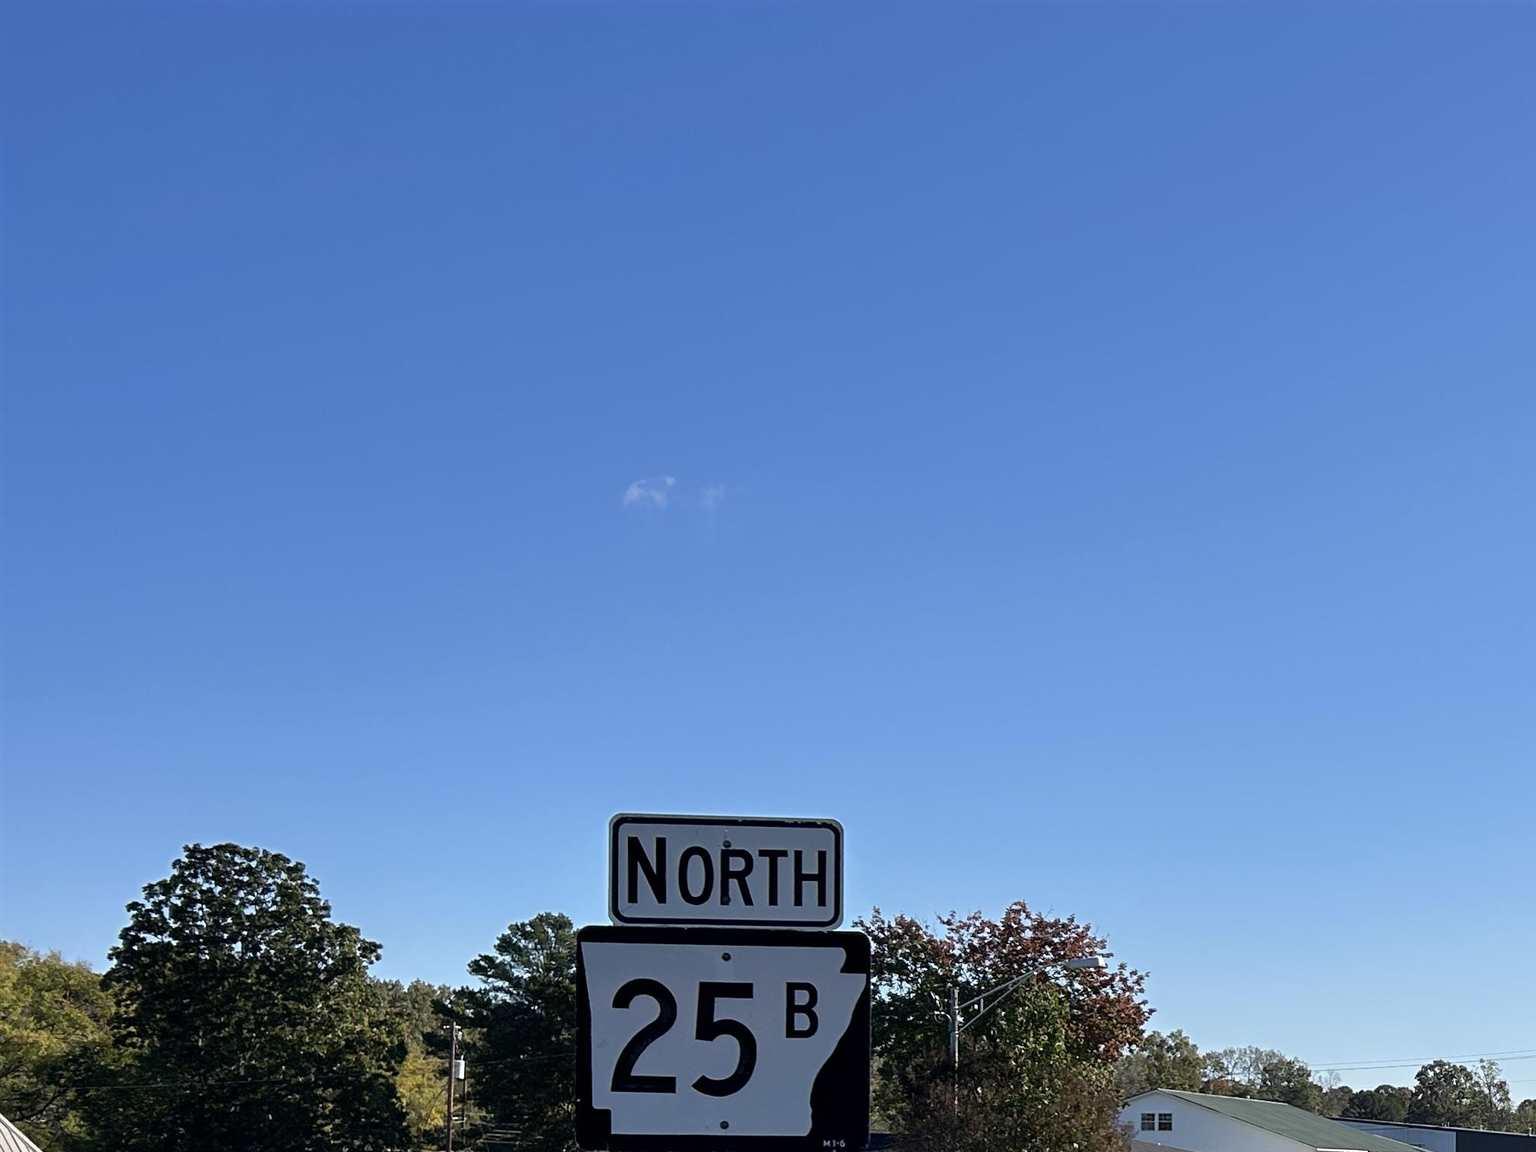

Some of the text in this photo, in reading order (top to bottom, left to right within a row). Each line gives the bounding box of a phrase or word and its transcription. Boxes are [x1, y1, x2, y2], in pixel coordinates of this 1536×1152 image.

[626, 836, 828, 907] NORTH
[610, 977, 820, 1098] 25 B
